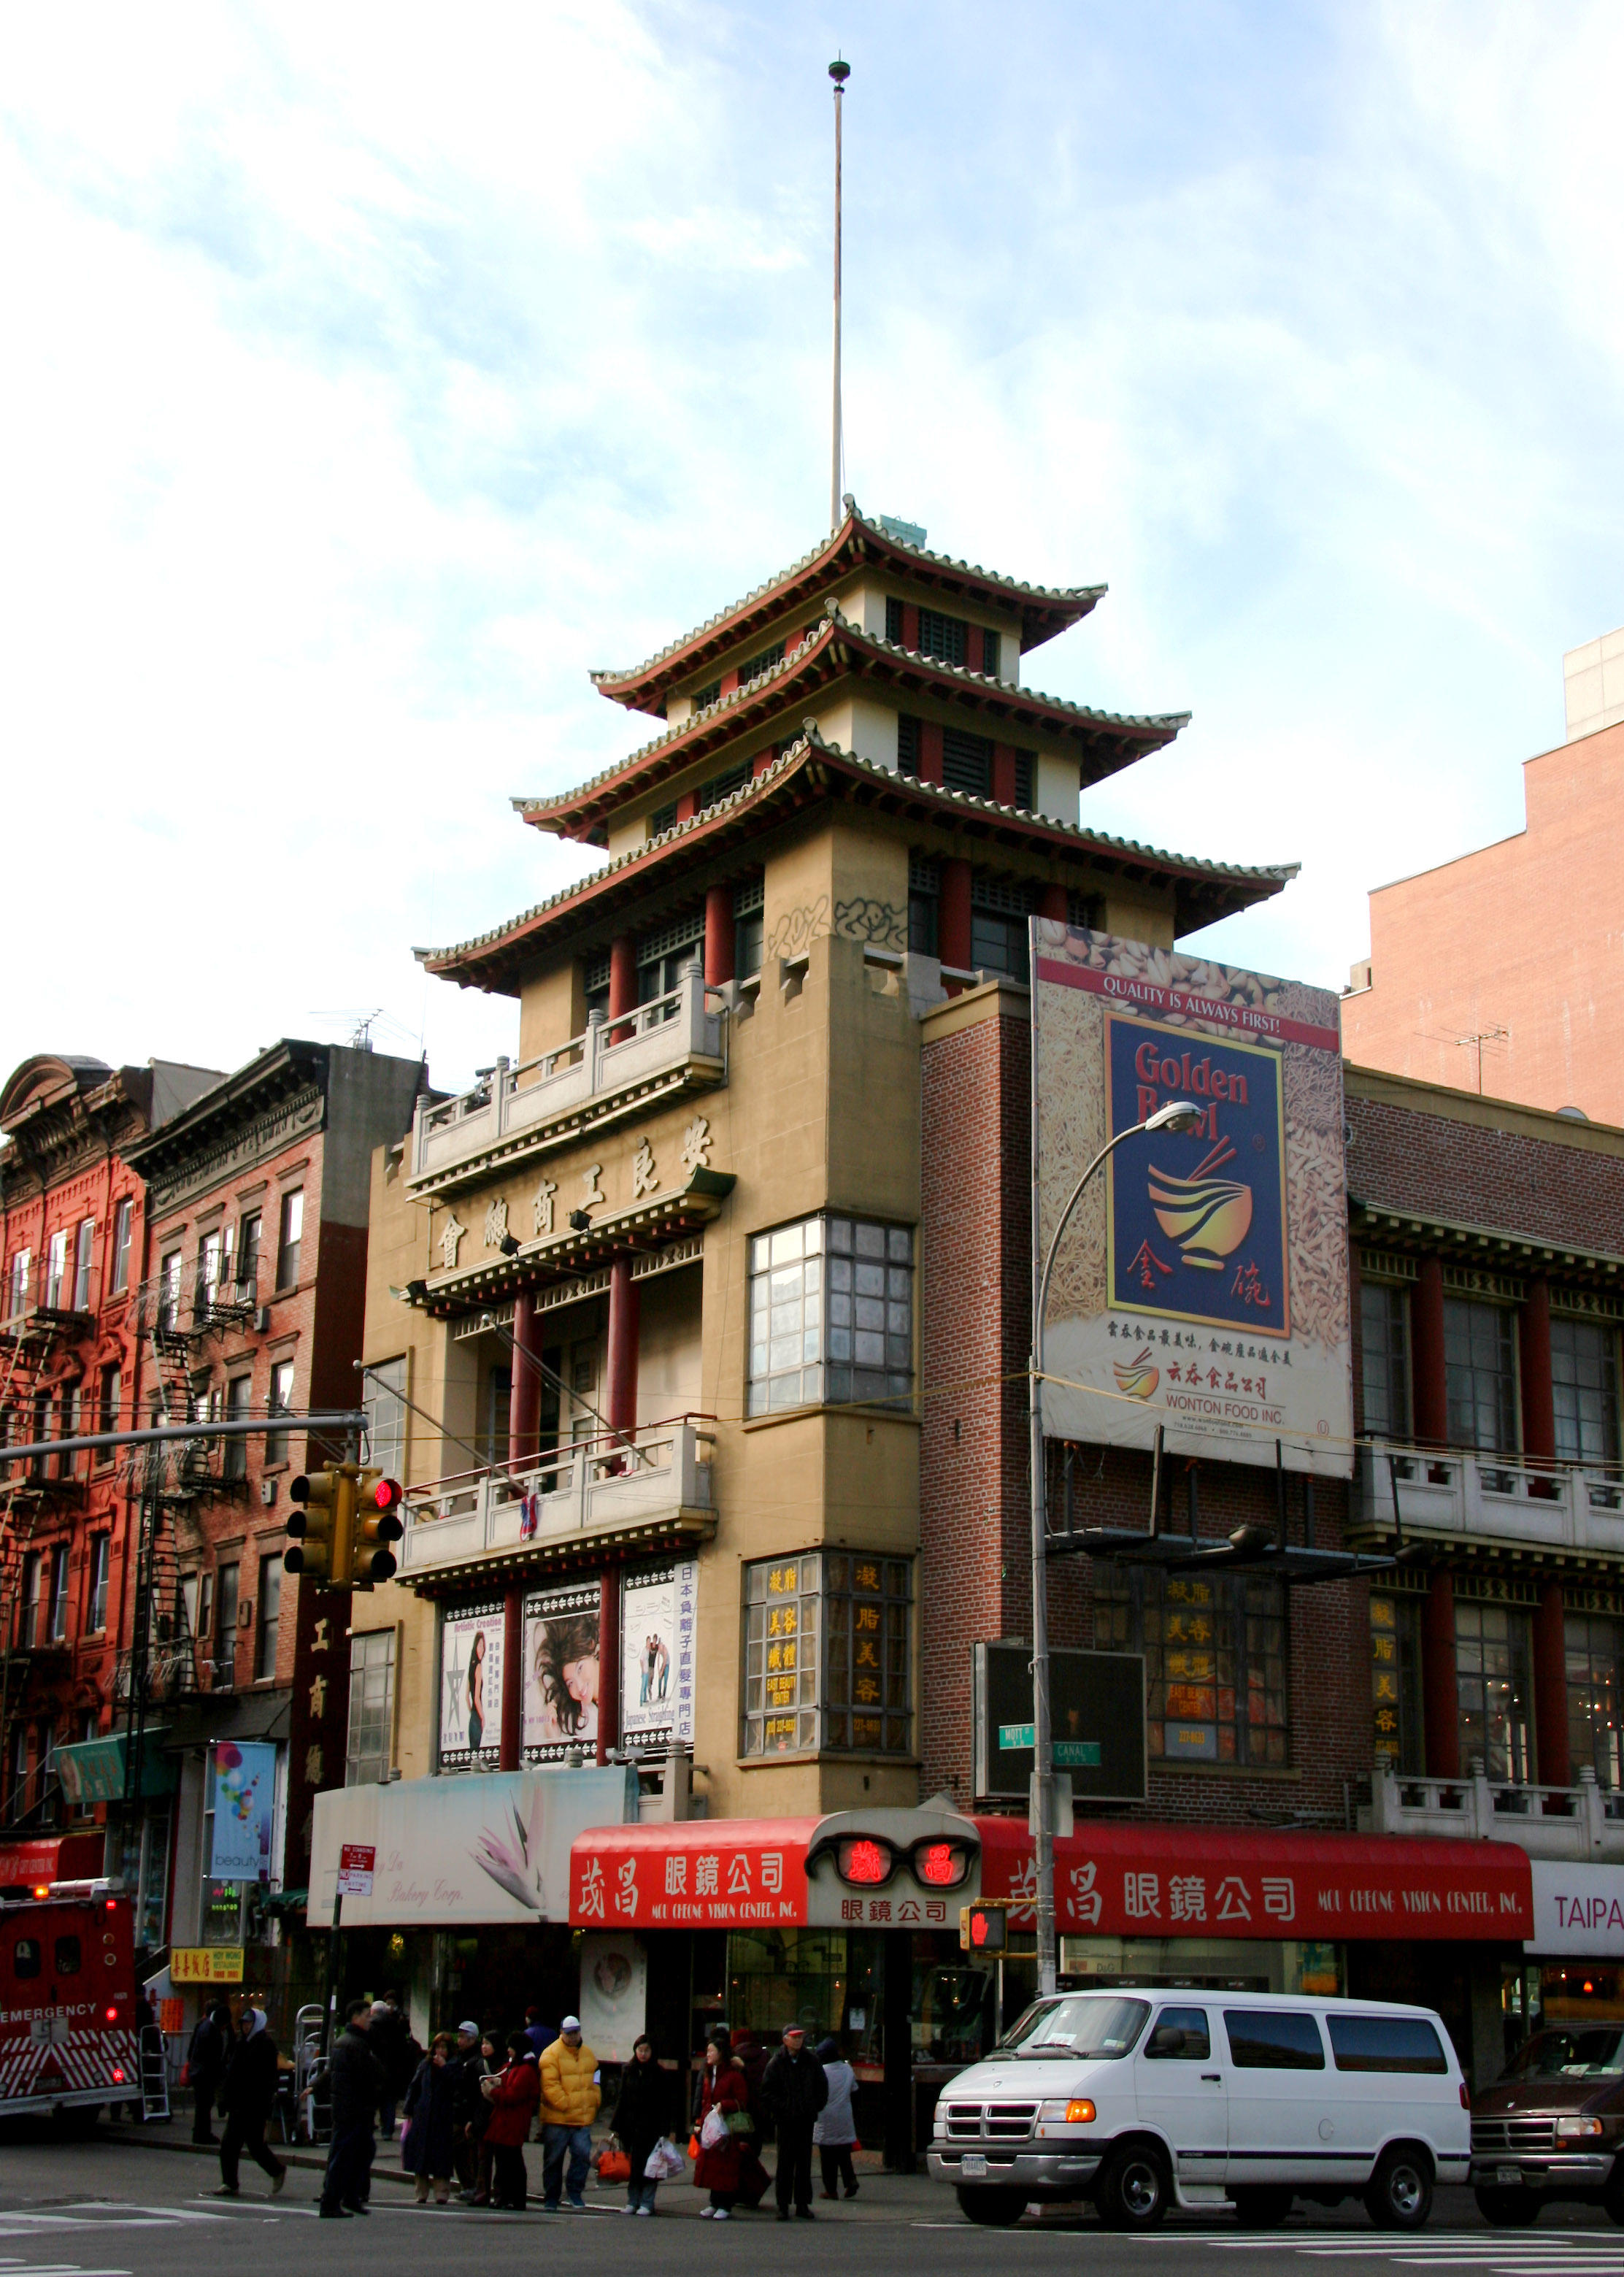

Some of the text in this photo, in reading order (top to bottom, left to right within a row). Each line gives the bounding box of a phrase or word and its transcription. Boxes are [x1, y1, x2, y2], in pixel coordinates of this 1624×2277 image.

[1103, 977, 1280, 1033] QUALITY IS ALWAYS FIRST!
[1135, 1042, 1250, 1106] Golden
[1136, 1083, 1218, 1141] Bwl
[1166, 1361, 1268, 1400] 云吞食品公司
[1166, 1394, 1285, 1425] WONTON FOOD INC.
[1005, 1729, 1023, 1741] MOTT
[1057, 1745, 1086, 1757] CANAL
[215, 1855, 258, 1867] beauty
[578, 1852, 783, 1919] 茂昌 眼鏡公司
[1124, 1872, 1296, 1921] 眼鏡公司
[708, 1902, 735, 1919] VISION
[739, 1902, 775, 1918] CENTER,
[842, 1900, 946, 1921] 眼鏡公司
[1350, 1889, 1395, 1913] CHEONG
[1401, 1890, 1441, 1913] VISION
[1447, 1891, 1494, 1914] CENTER,
[1555, 1897, 1624, 1929] TAIPA
[1, 2003, 97, 2022] EMERGENCY
